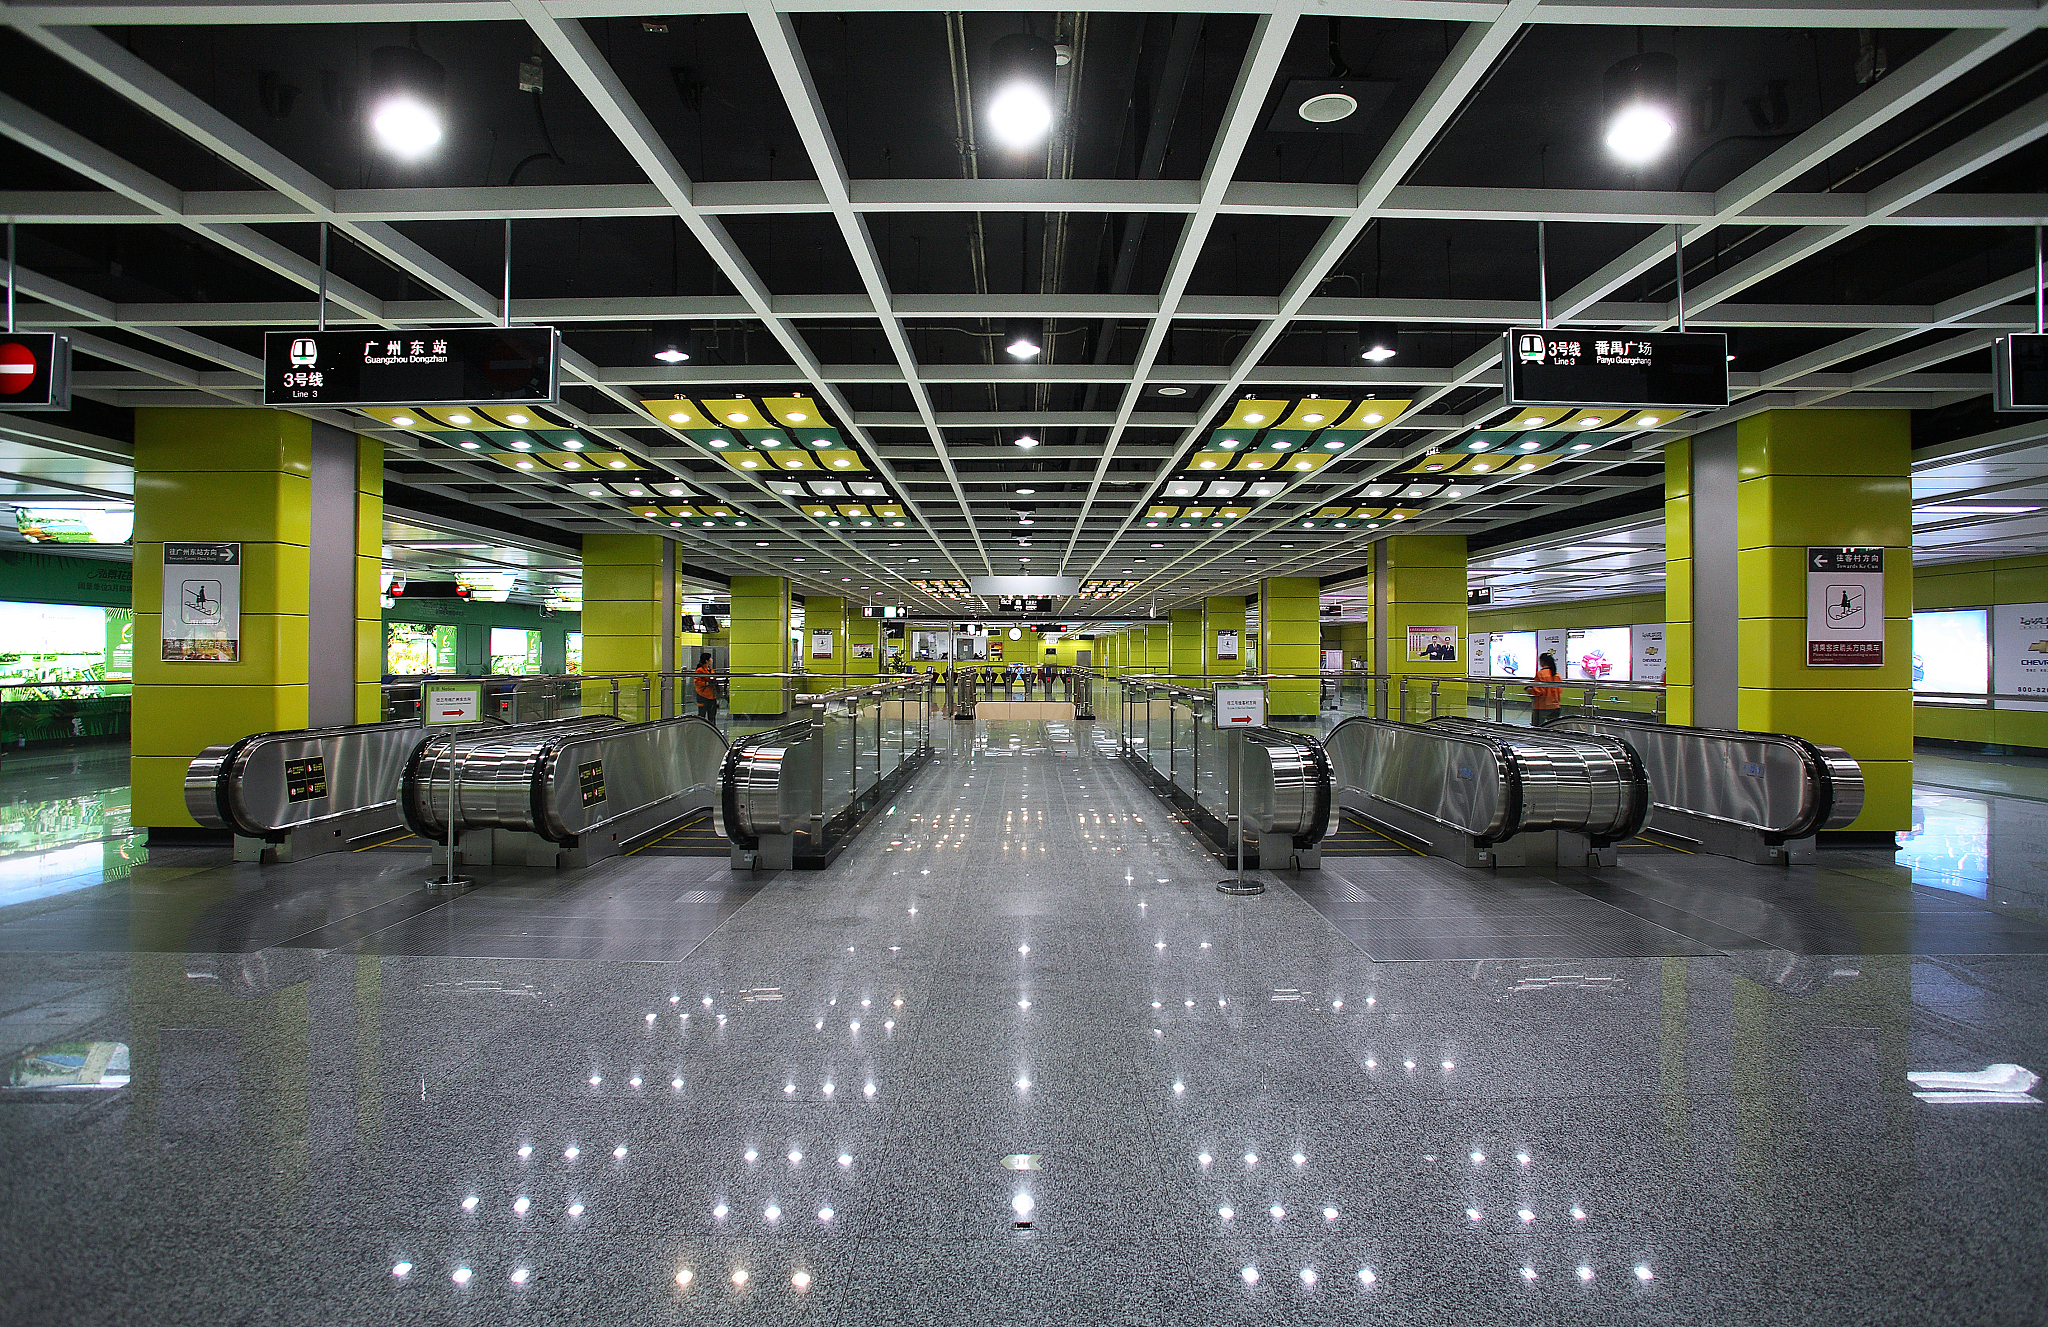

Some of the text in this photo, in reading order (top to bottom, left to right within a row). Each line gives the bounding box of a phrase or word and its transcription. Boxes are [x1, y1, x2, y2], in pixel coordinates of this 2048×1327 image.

[364, 339, 448, 356] 广州东站
[1548, 341, 1581, 357] 3号线
[1594, 340, 1652, 356] 番禺广场
[364, 355, 448, 365] Guangzhou Dongzhan
[1553, 357, 1576, 366] Line 3
[1596, 356, 1652, 366] Panyu Guangchang
[283, 372, 324, 388] 3号线
[292, 390, 309, 398] Line
[169, 548, 217, 556] 往广州东站方向
[1836, 554, 1879, 563] 往客村方向
[1812, 643, 1880, 652] 请乘客按箭头方向乘车
